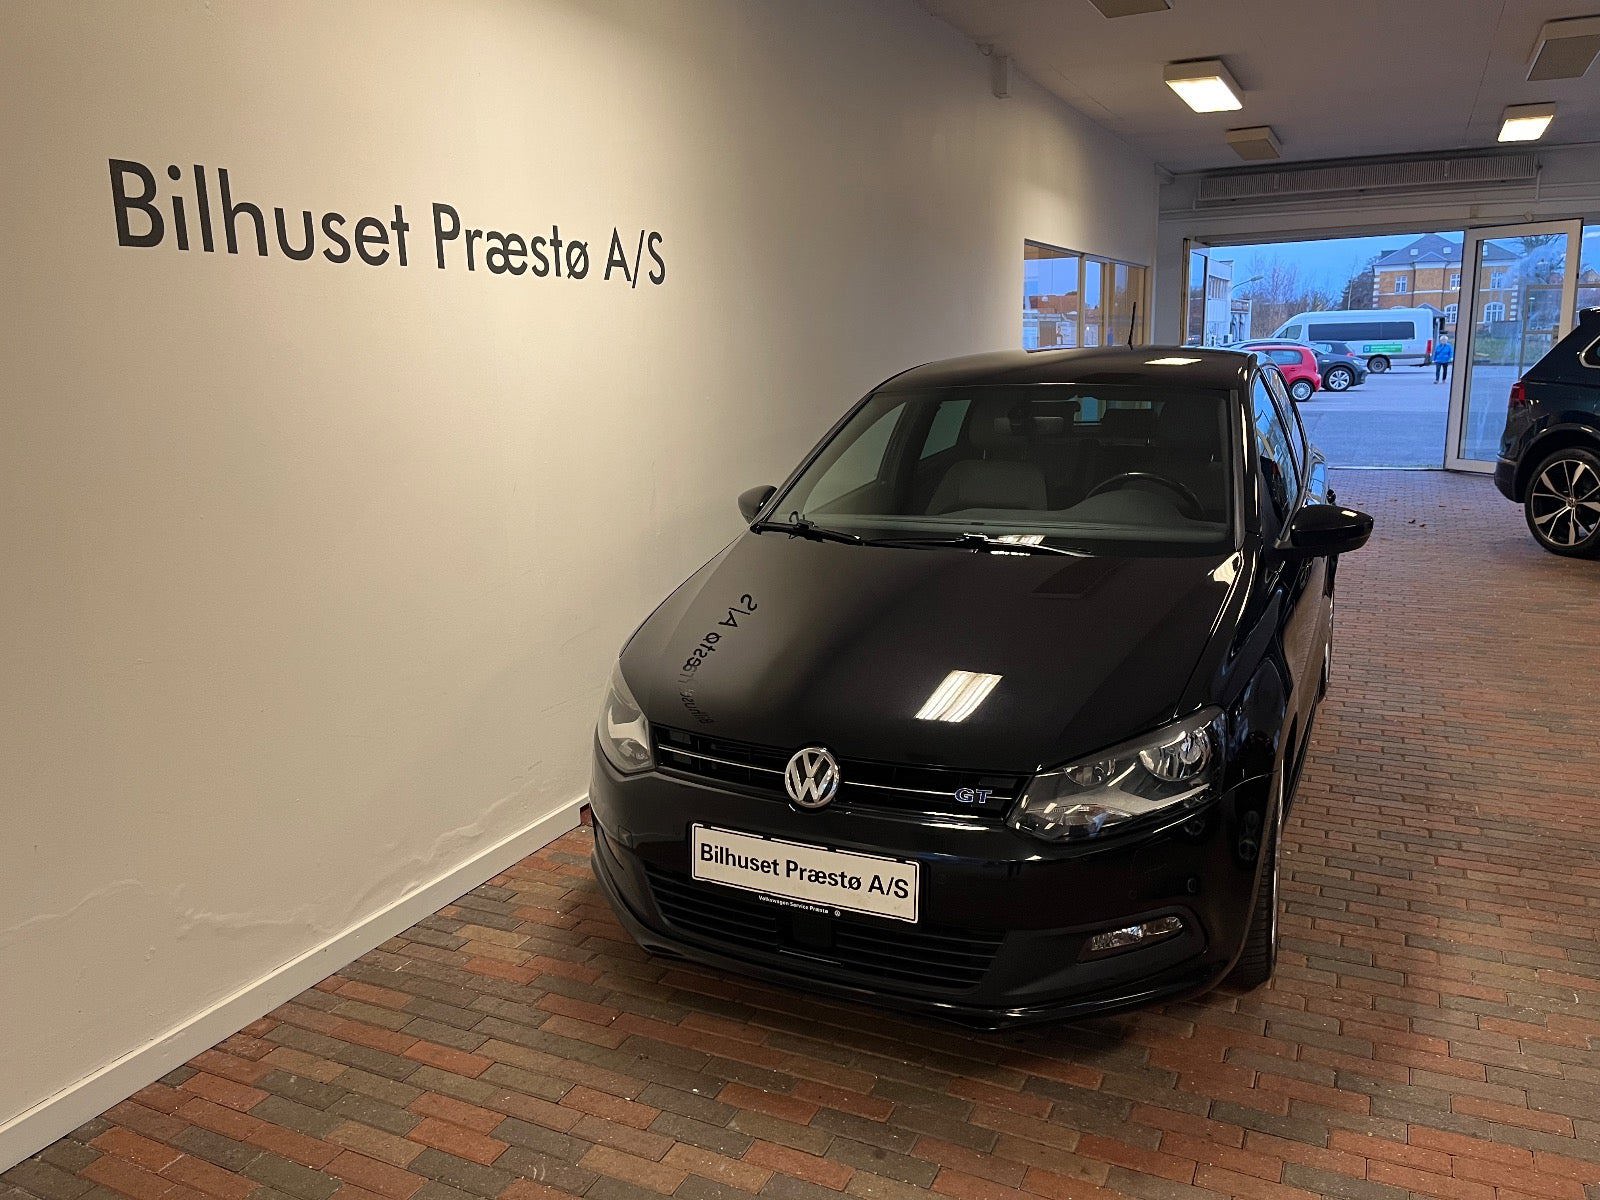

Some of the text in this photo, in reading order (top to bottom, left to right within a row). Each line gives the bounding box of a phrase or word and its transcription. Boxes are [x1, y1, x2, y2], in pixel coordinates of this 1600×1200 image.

[109, 159, 666, 289] Bilhuset Præstø A/S
[954, 787, 993, 804] GT
[700, 842, 909, 899] Bilhuset Præstø A/S
[758, 895, 789, 905] Volkswagen
[790, 902, 809, 910] Service
